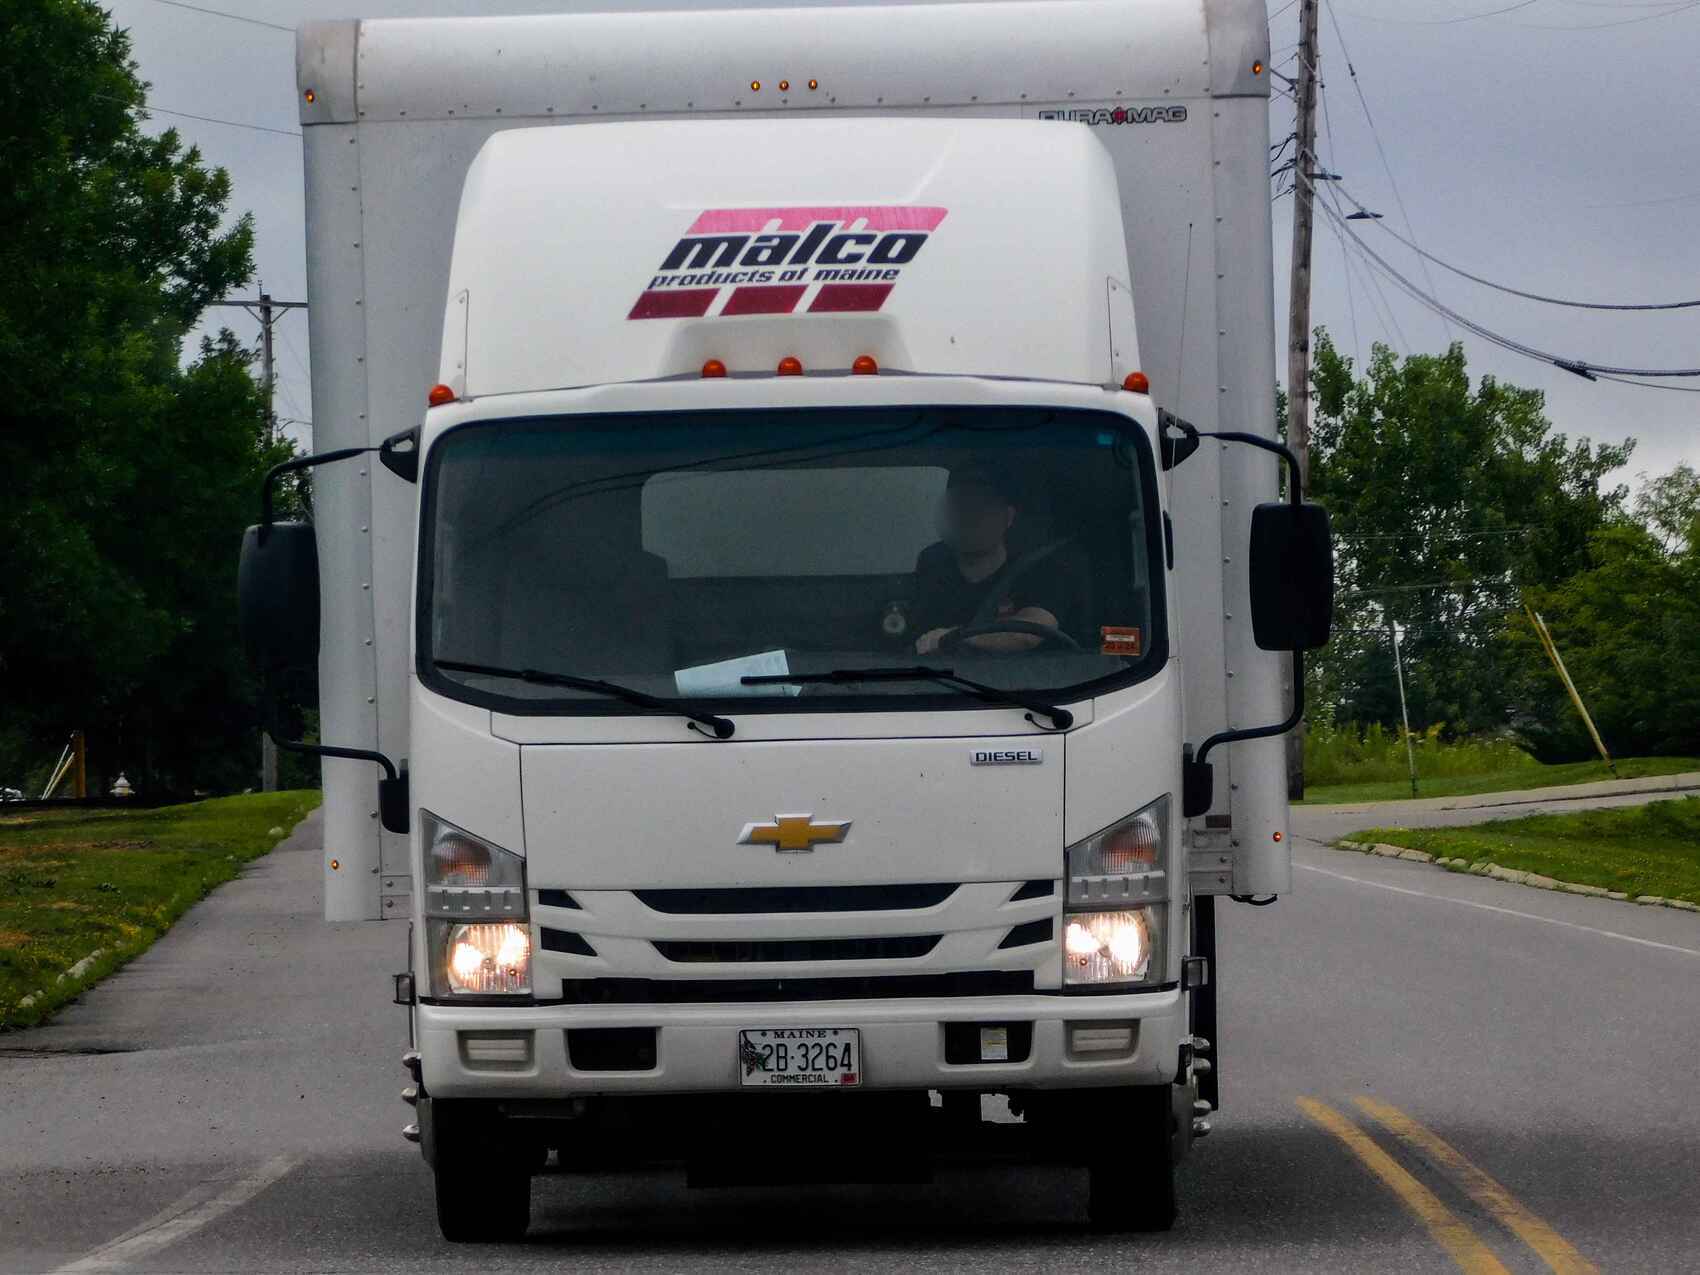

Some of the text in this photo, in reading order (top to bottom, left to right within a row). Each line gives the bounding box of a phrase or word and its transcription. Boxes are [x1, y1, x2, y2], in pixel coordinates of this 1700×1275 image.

[659, 223, 930, 270] malco
[647, 267, 900, 289] products of maine
[975, 751, 1038, 762] DIESEL
[774, 1030, 827, 1039] MAINE
[770, 1073, 829, 1083] COMMERCIAL
